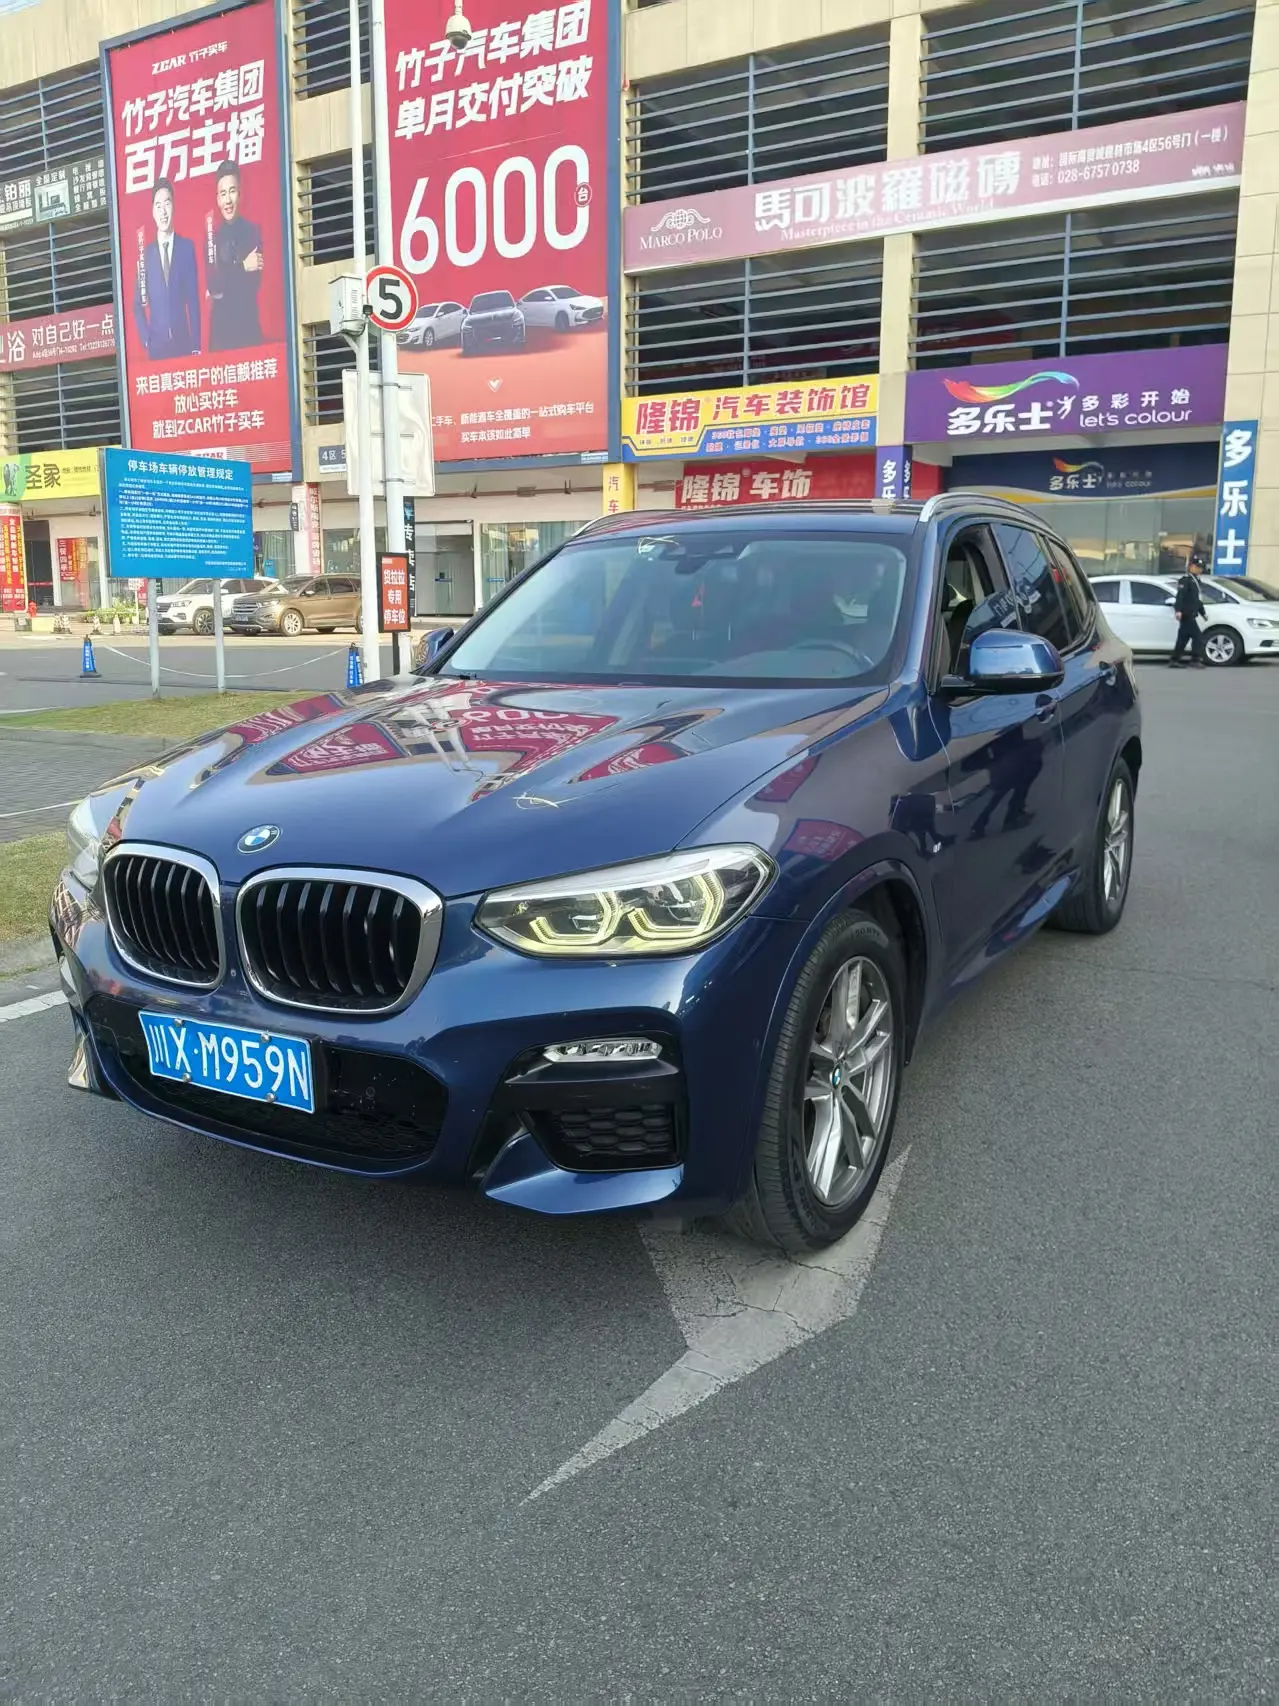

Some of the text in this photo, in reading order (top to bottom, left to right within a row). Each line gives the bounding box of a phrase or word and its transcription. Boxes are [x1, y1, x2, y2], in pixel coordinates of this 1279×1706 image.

[152, 41, 228, 75] ZCAR 竹子买车
[395, 1, 591, 91] 竹子汽车集团
[122, 59, 264, 137] 竹子汽车集团
[395, 55, 593, 140] 单月交付突破
[125, 104, 264, 193] 百万主播
[1112, 160, 1140, 176] 0738
[578, 187, 588, 201] 台
[754, 151, 1021, 231] 馬可波羅磁磚
[400, 144, 589, 275] 6000
[640, 227, 722, 250] MARCO POLO
[379, 277, 403, 320] 5
[32, 313, 114, 347] 对自己好一点
[136, 358, 277, 395] 来自真实用户的信赖推荐
[174, 388, 238, 414] 放心买好车
[636, 384, 870, 435] 隆锦 汽车装饰馆
[947, 389, 1190, 434] 多乐士 多彩开始
[1079, 408, 1193, 428] let's colour
[152, 411, 265, 439] 就到ZCAR竹子买车
[127, 459, 233, 480] 停车场车辆停放管理规定
[322, 450, 337, 460] 4区
[25, 463, 61, 489] 圣象
[682, 468, 814, 503] 隆锦 车饰
[1049, 474, 1097, 490] 多乐士
[608, 475, 620, 513] 汽车
[1217, 429, 1253, 565] 多乐士
[384, 569, 405, 585] 货拉拉
[388, 589, 401, 604] 专用
[384, 609, 405, 624] 停车位
[149, 1024, 309, 1100] 川X·M959N
